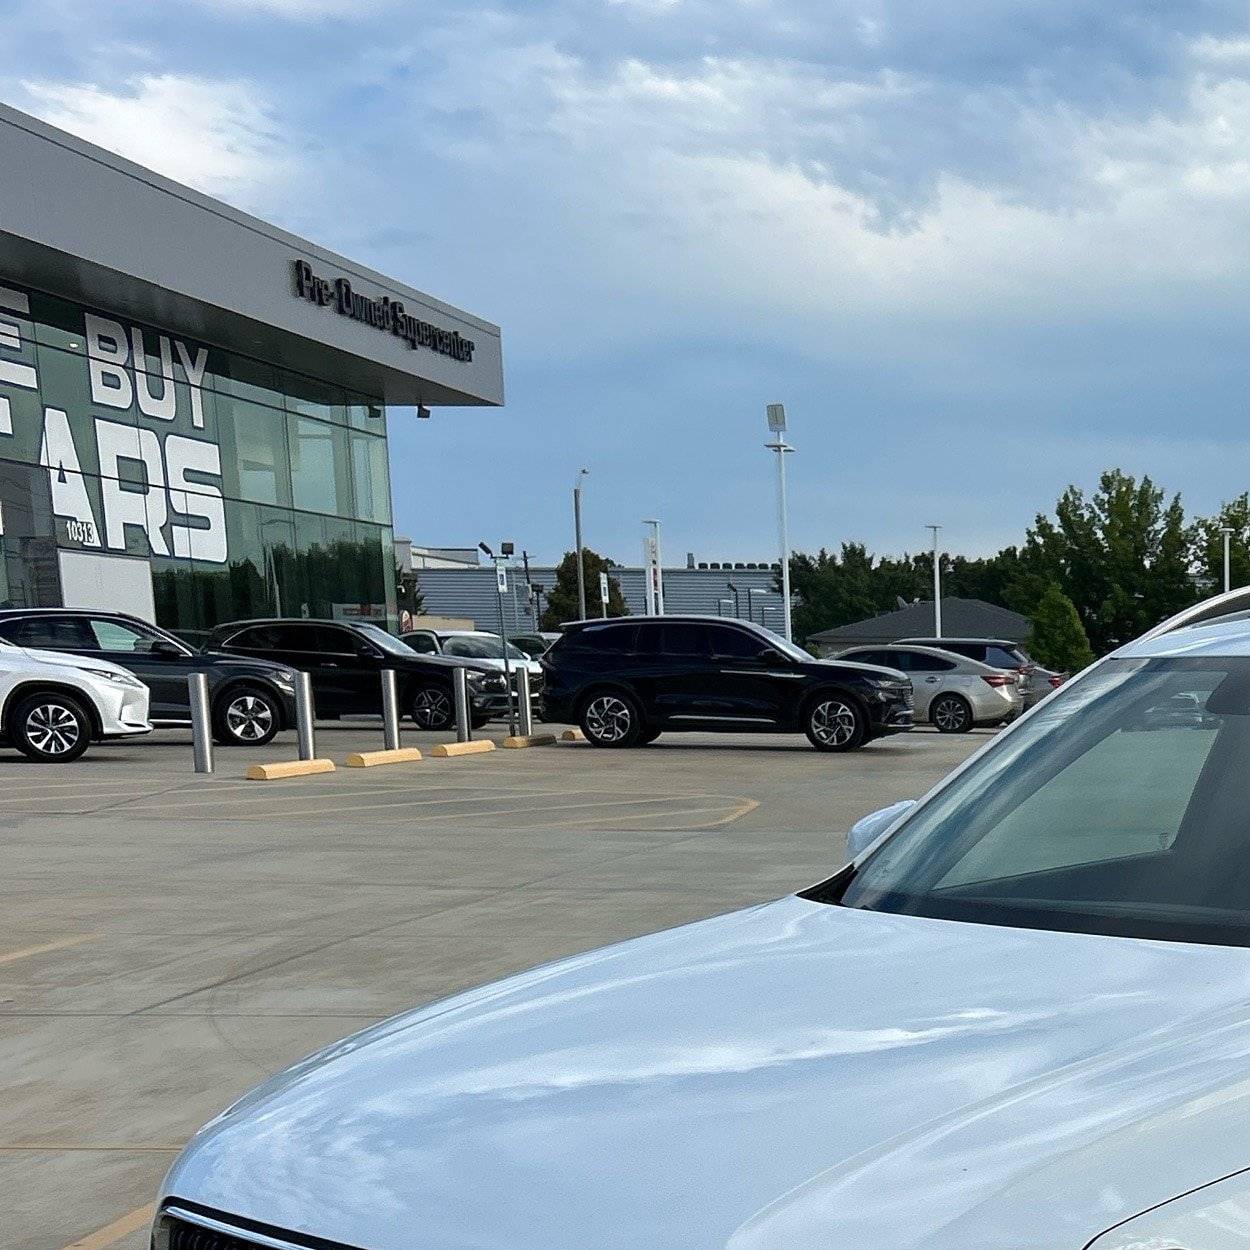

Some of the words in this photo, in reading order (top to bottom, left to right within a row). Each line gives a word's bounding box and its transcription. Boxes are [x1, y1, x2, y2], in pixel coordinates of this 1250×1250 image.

[84, 312, 208, 429] BUY
[392, 301, 476, 362] Supercenter
[0, 397, 228, 563] ARS
[66, 519, 95, 543] 10313
